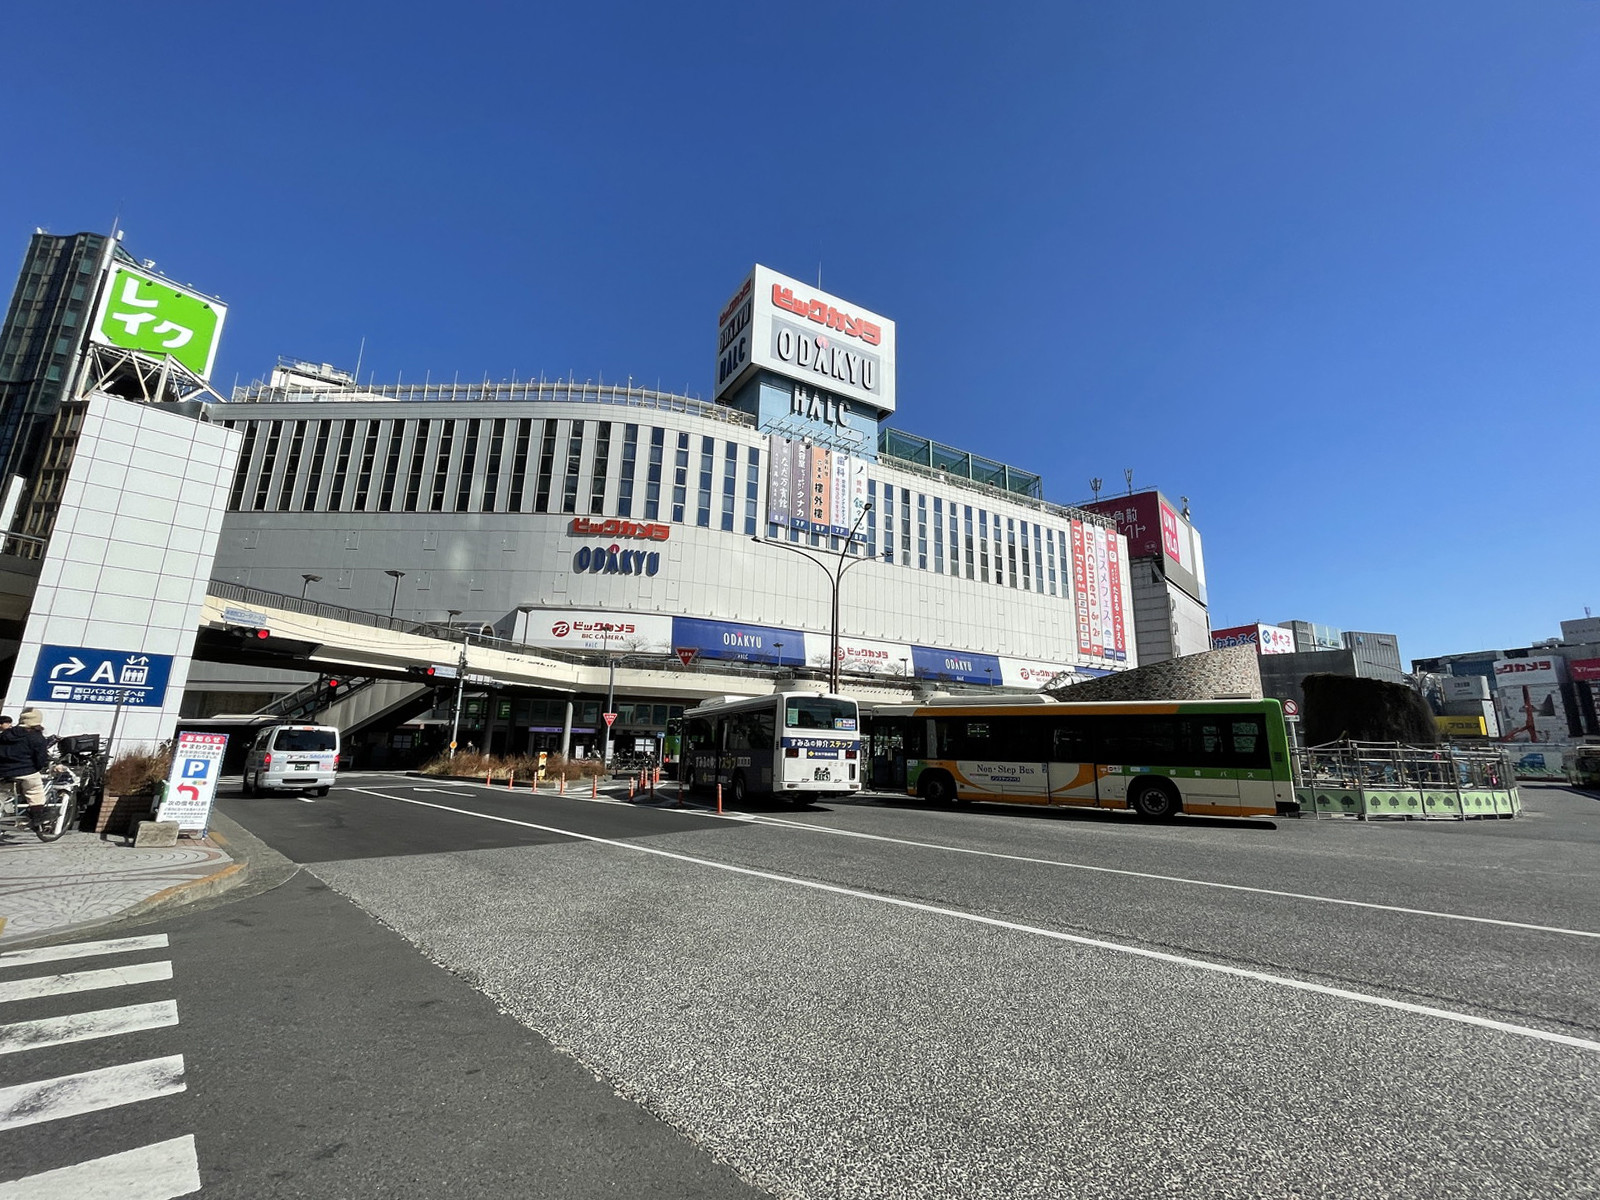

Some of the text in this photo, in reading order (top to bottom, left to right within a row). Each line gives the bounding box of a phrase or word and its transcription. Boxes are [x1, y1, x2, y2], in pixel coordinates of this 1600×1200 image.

[772, 283, 882, 346] ビックカメラ
[719, 337, 746, 384] HALC
[777, 326, 876, 390] ODAKYU
[791, 384, 851, 428] HALC
[571, 517, 670, 541] ビックカメラ
[795, 520, 806, 528] 7F
[815, 524, 825, 532] 8F
[575, 545, 660, 577] ODAKYU
[1086, 531, 1097, 606] BicCamera
[1098, 547, 1110, 621] コスメフェス
[573, 621, 635, 634] ビックカメラ
[723, 632, 762, 649] ODAKYU
[847, 647, 889, 660] ビックカメラ
[89, 660, 116, 684] A
[945, 658, 973, 672] ODAKYU
[185, 735, 222, 744] お知らせ
[187, 761, 205, 776] P
[1019, 765, 1035, 774] Bus
